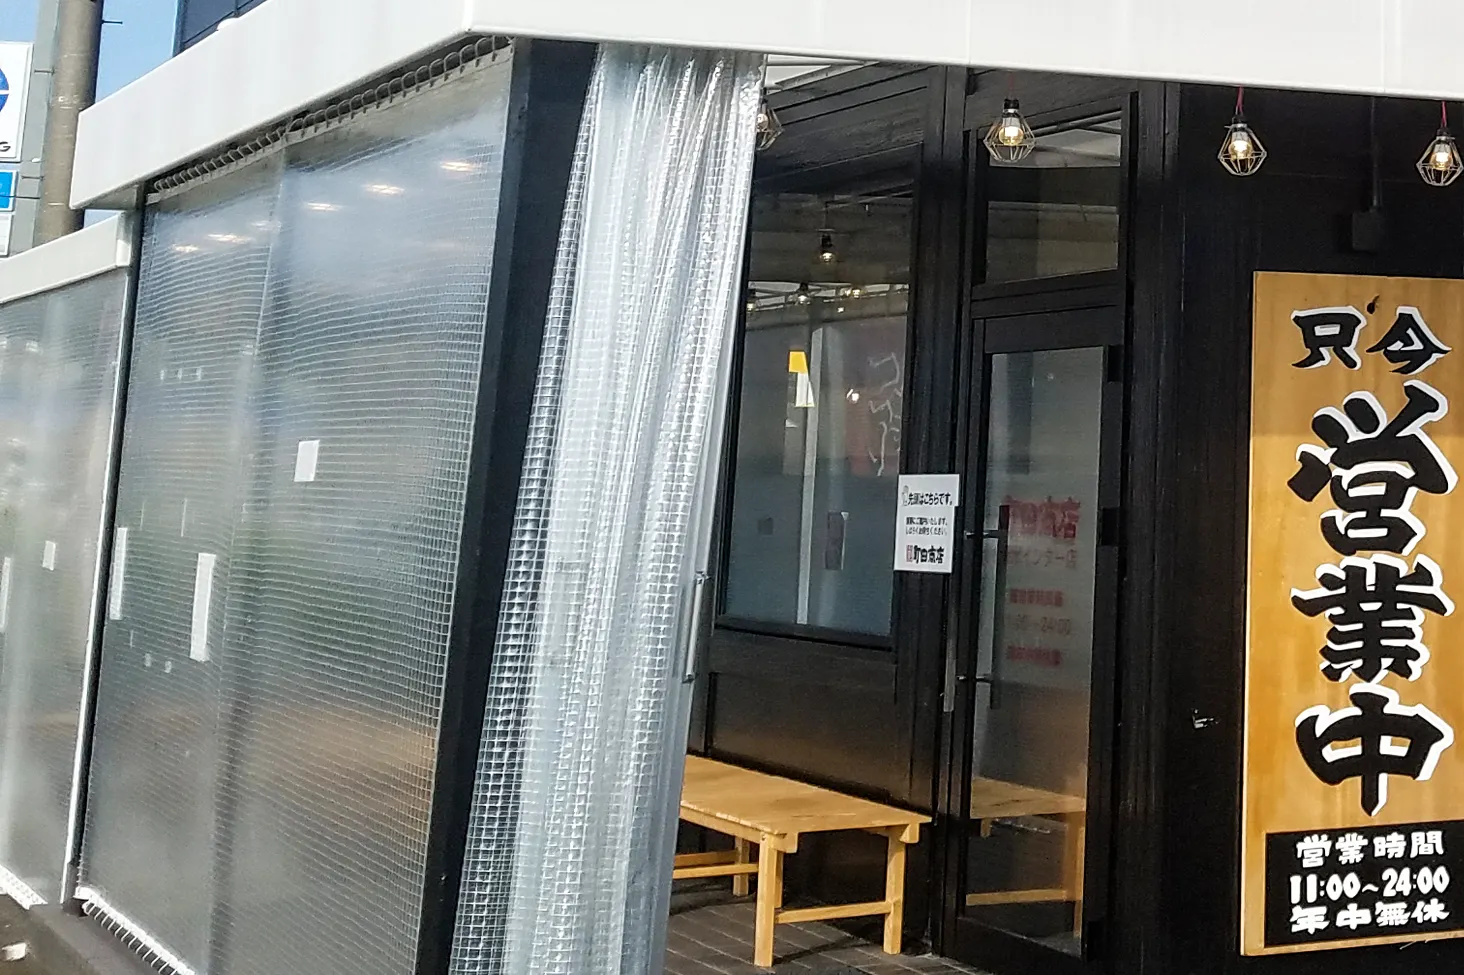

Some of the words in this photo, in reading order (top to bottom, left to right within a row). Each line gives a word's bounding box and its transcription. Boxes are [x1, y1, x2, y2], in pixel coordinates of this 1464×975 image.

[1291, 305, 1452, 374] 只今
[1287, 379, 1458, 816] 営業中
[1296, 830, 1445, 868] 営業時間
[1289, 898, 1450, 934] 年中無休
